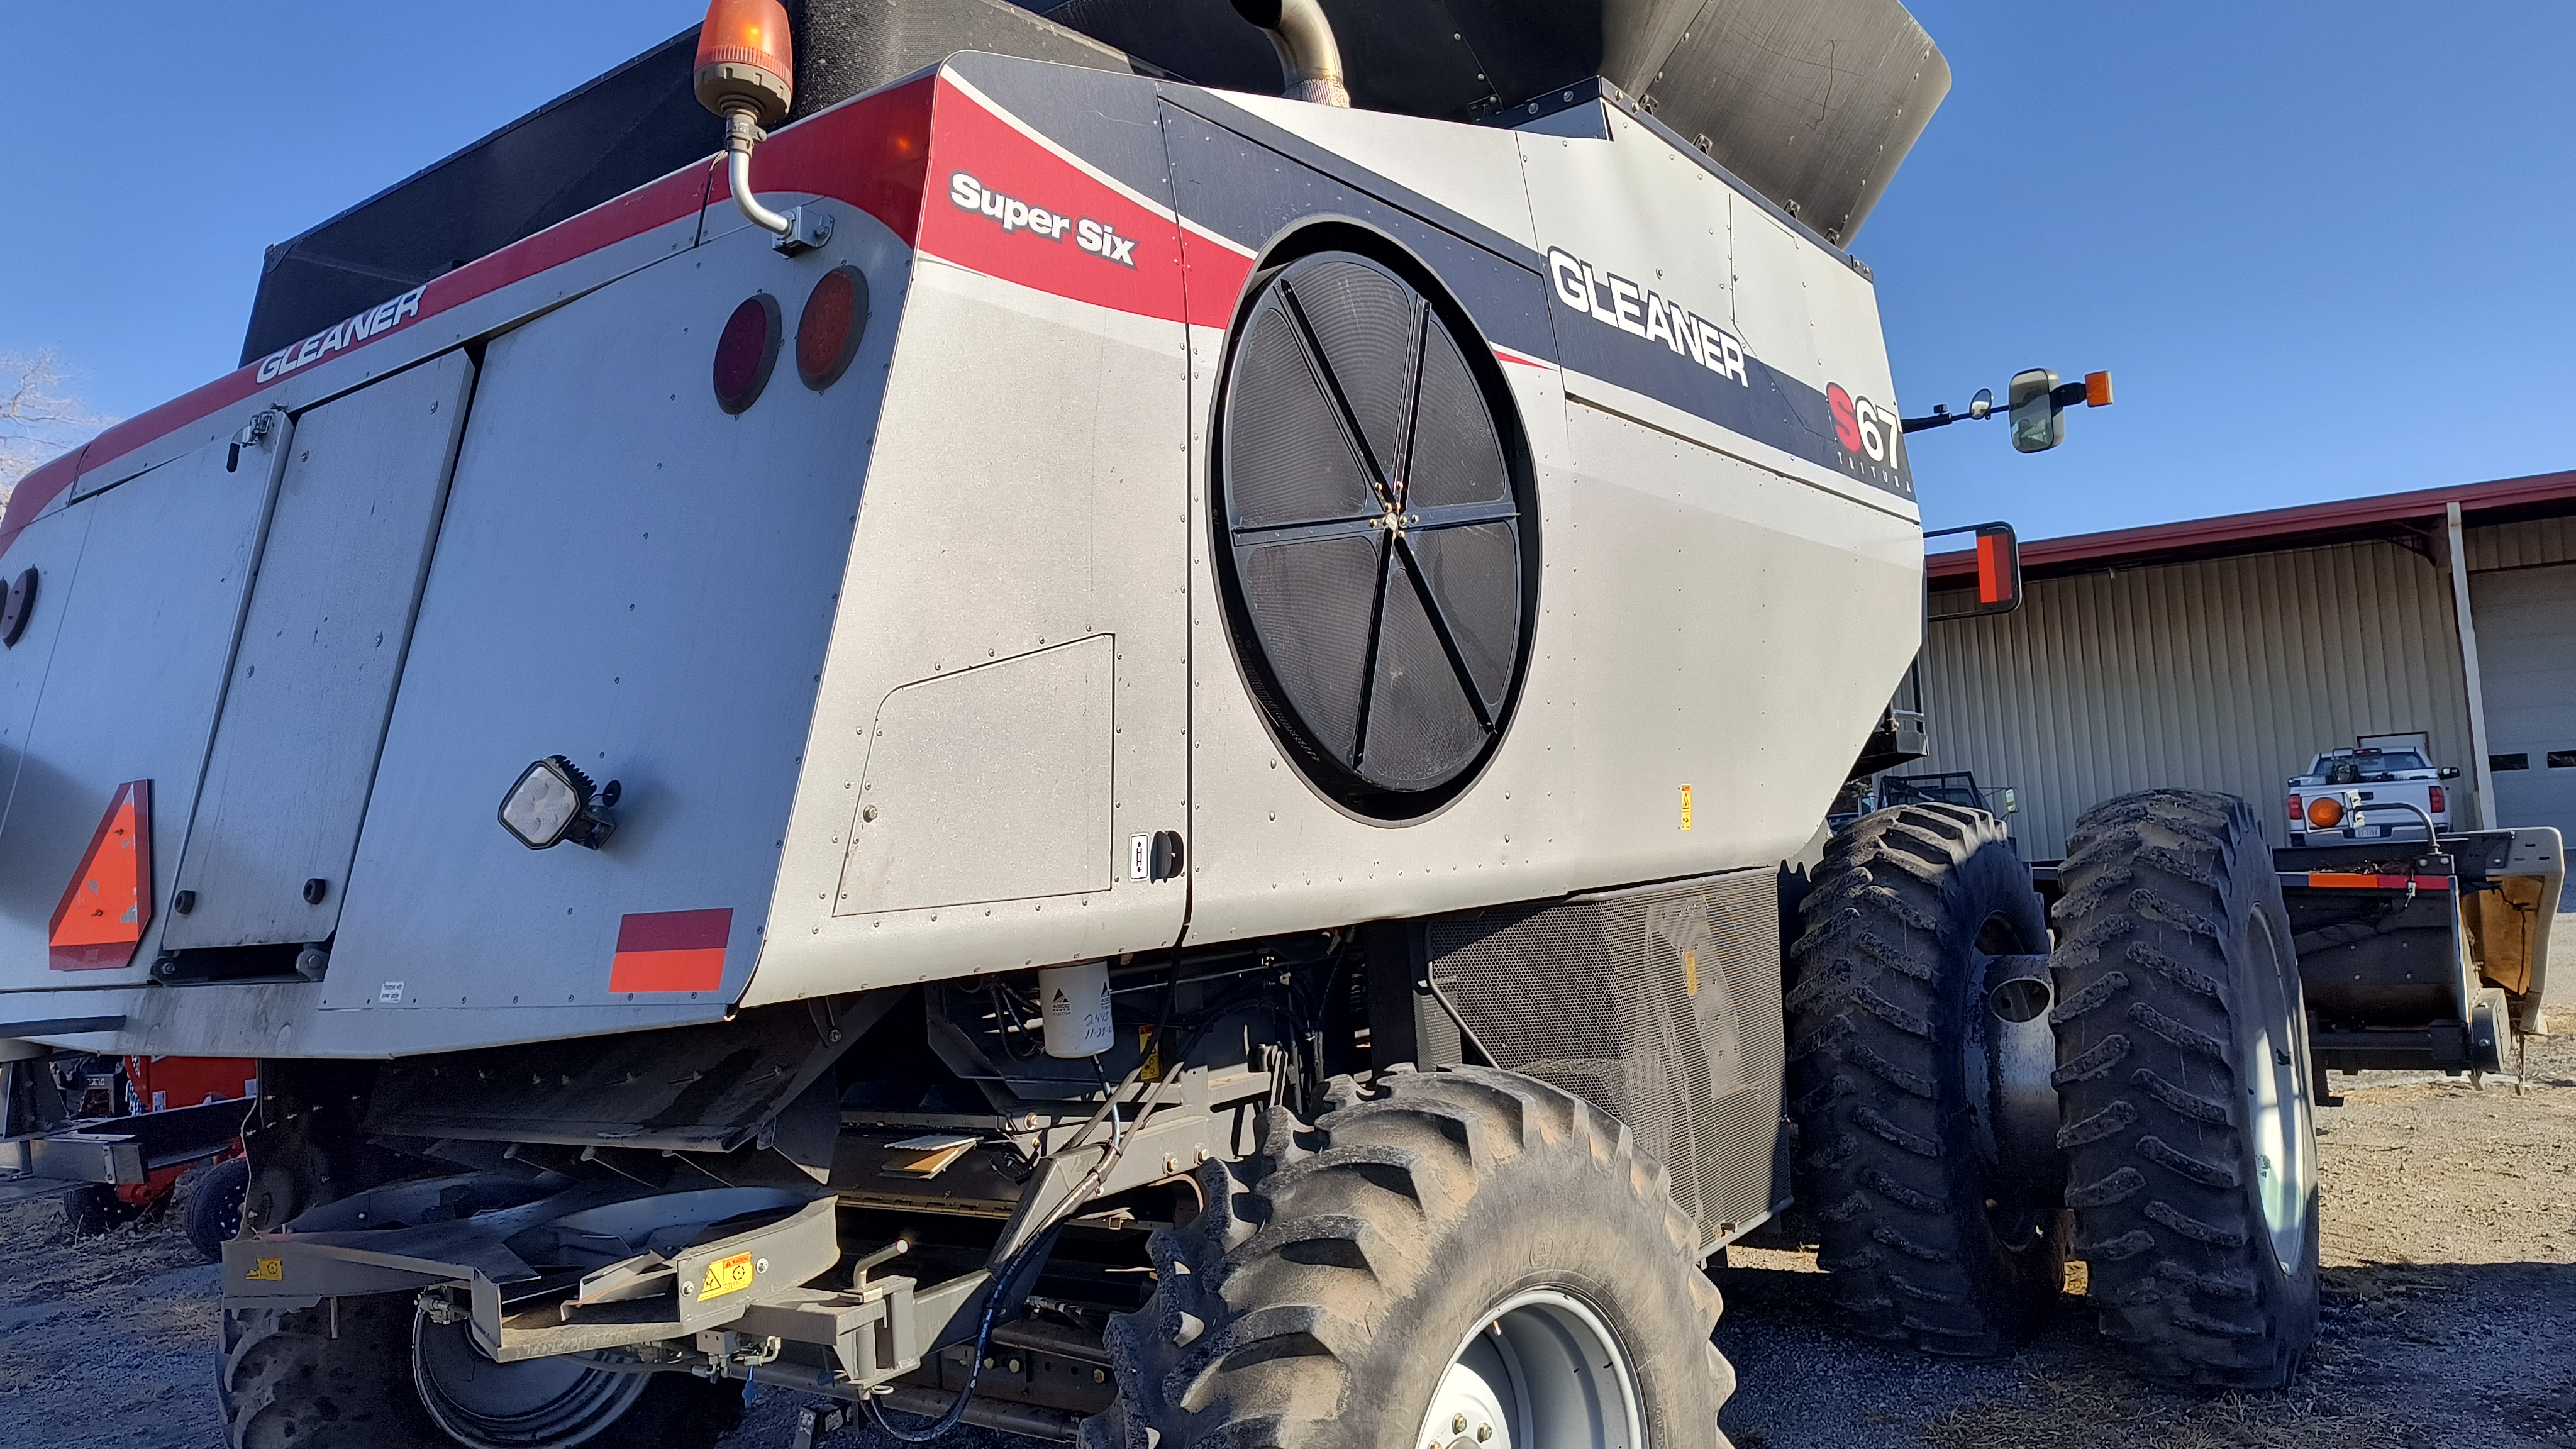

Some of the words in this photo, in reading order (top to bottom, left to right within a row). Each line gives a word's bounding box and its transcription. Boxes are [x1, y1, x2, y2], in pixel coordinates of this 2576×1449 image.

[950, 172, 1070, 240] Super
[1075, 218, 1136, 266] Six
[256, 285, 427, 383] GLEANER
[1548, 246, 1748, 388] GLEANER
[1826, 382, 1898, 470] S67
[1837, 451, 1911, 492] TRITURA
